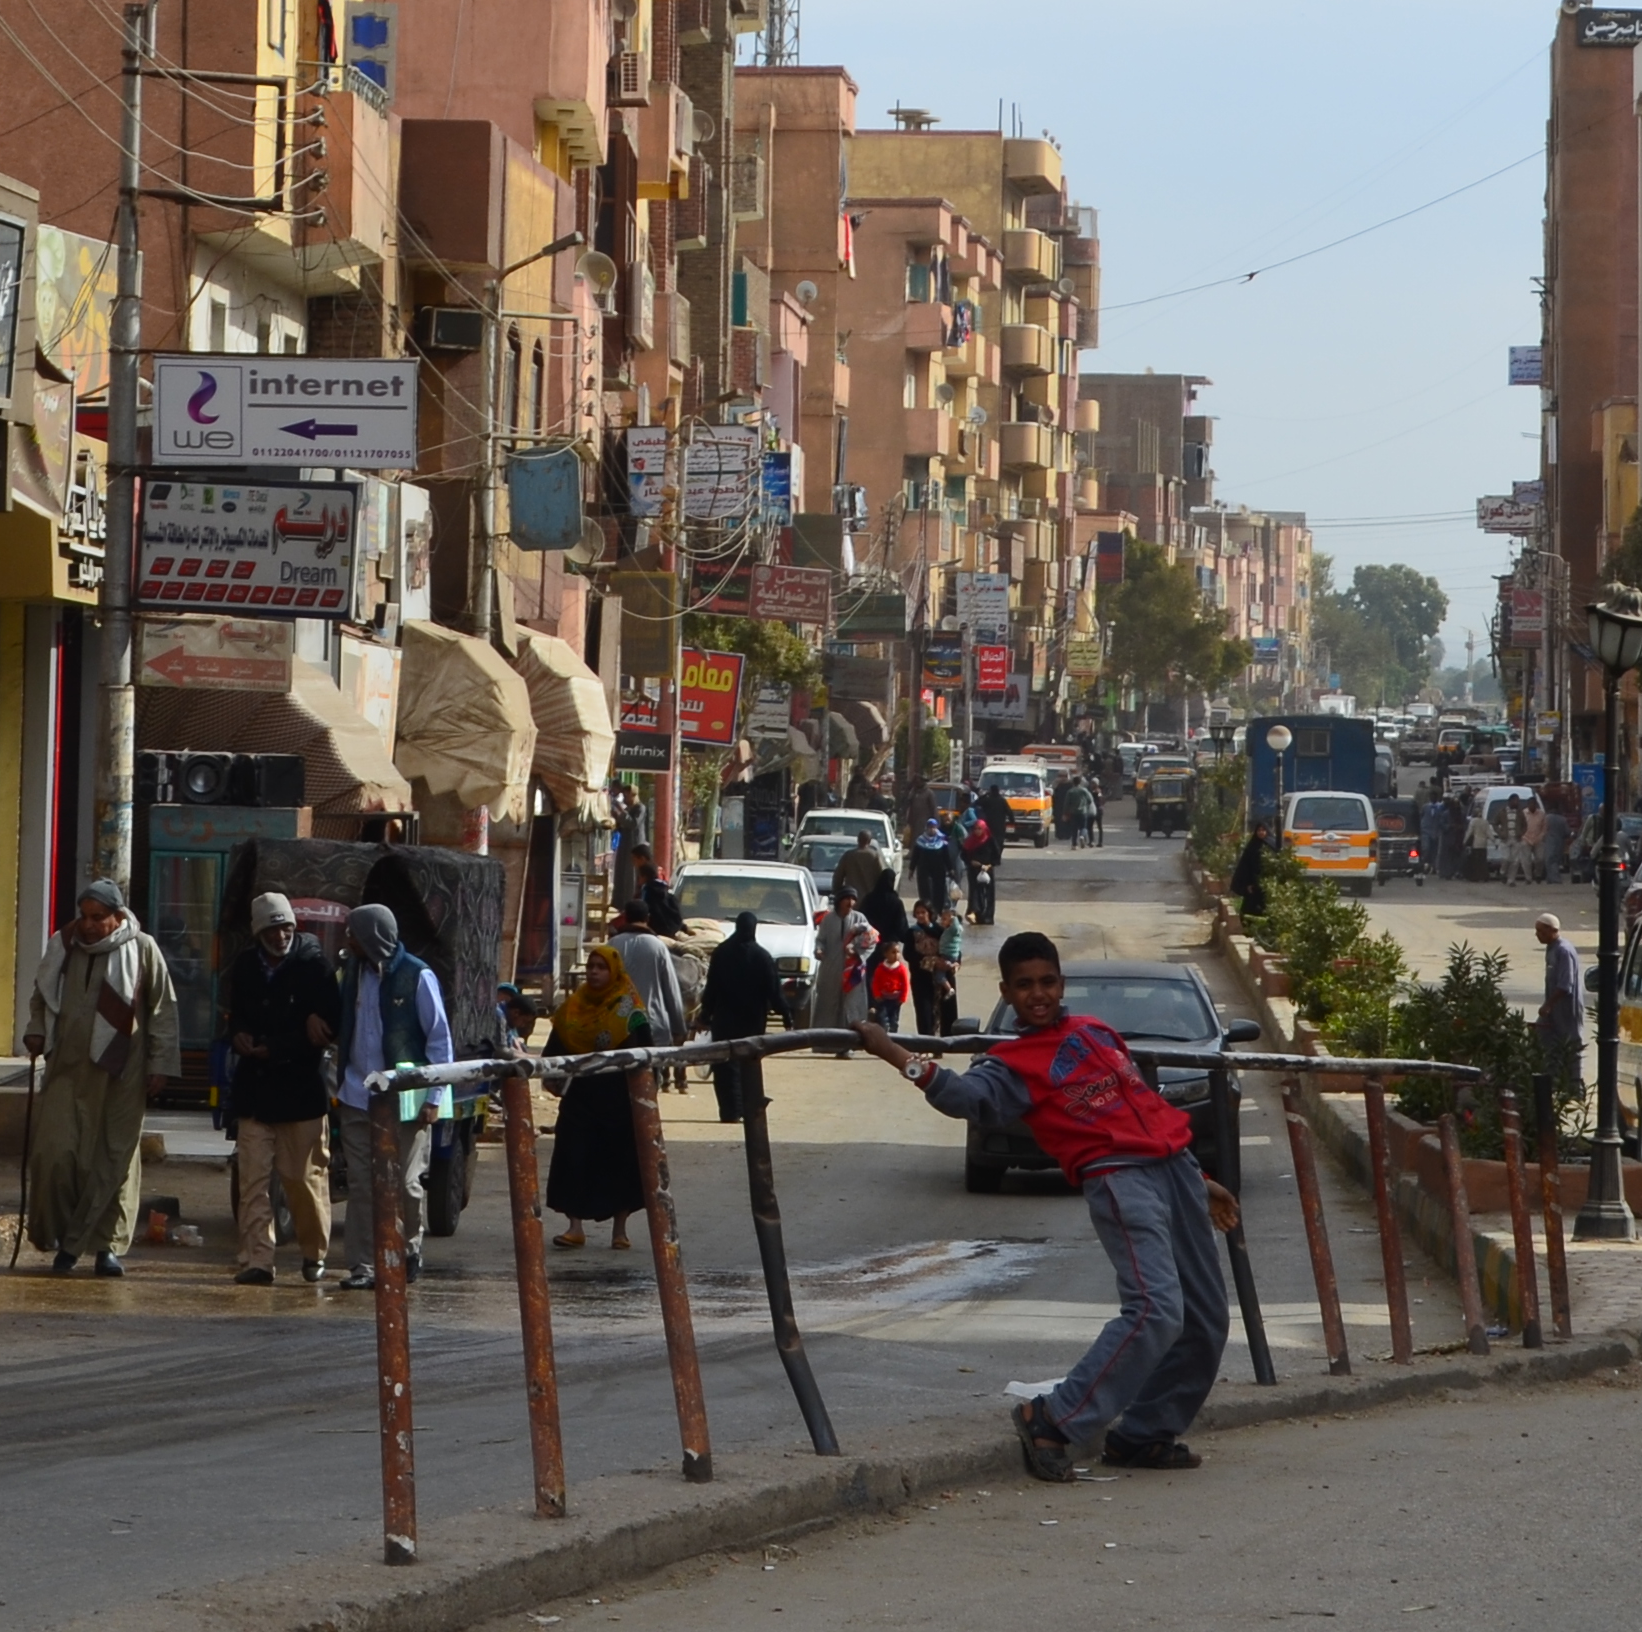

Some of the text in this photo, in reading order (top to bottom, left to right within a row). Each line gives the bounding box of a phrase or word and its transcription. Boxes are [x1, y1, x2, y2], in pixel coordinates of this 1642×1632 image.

[249, 370, 404, 397] internet
[173, 430, 234, 449] we
[252, 448, 411, 459] 01122041700/01121707055
[272, 503, 348, 559] دريم
[280, 561, 337, 584] Dream
[775, 570, 827, 585] معامل
[757, 582, 827, 607] الرضوانية
[682, 660, 733, 692] معام
[620, 745, 666, 758] Infinix
[1091, 1097, 1105, 1109] NO
